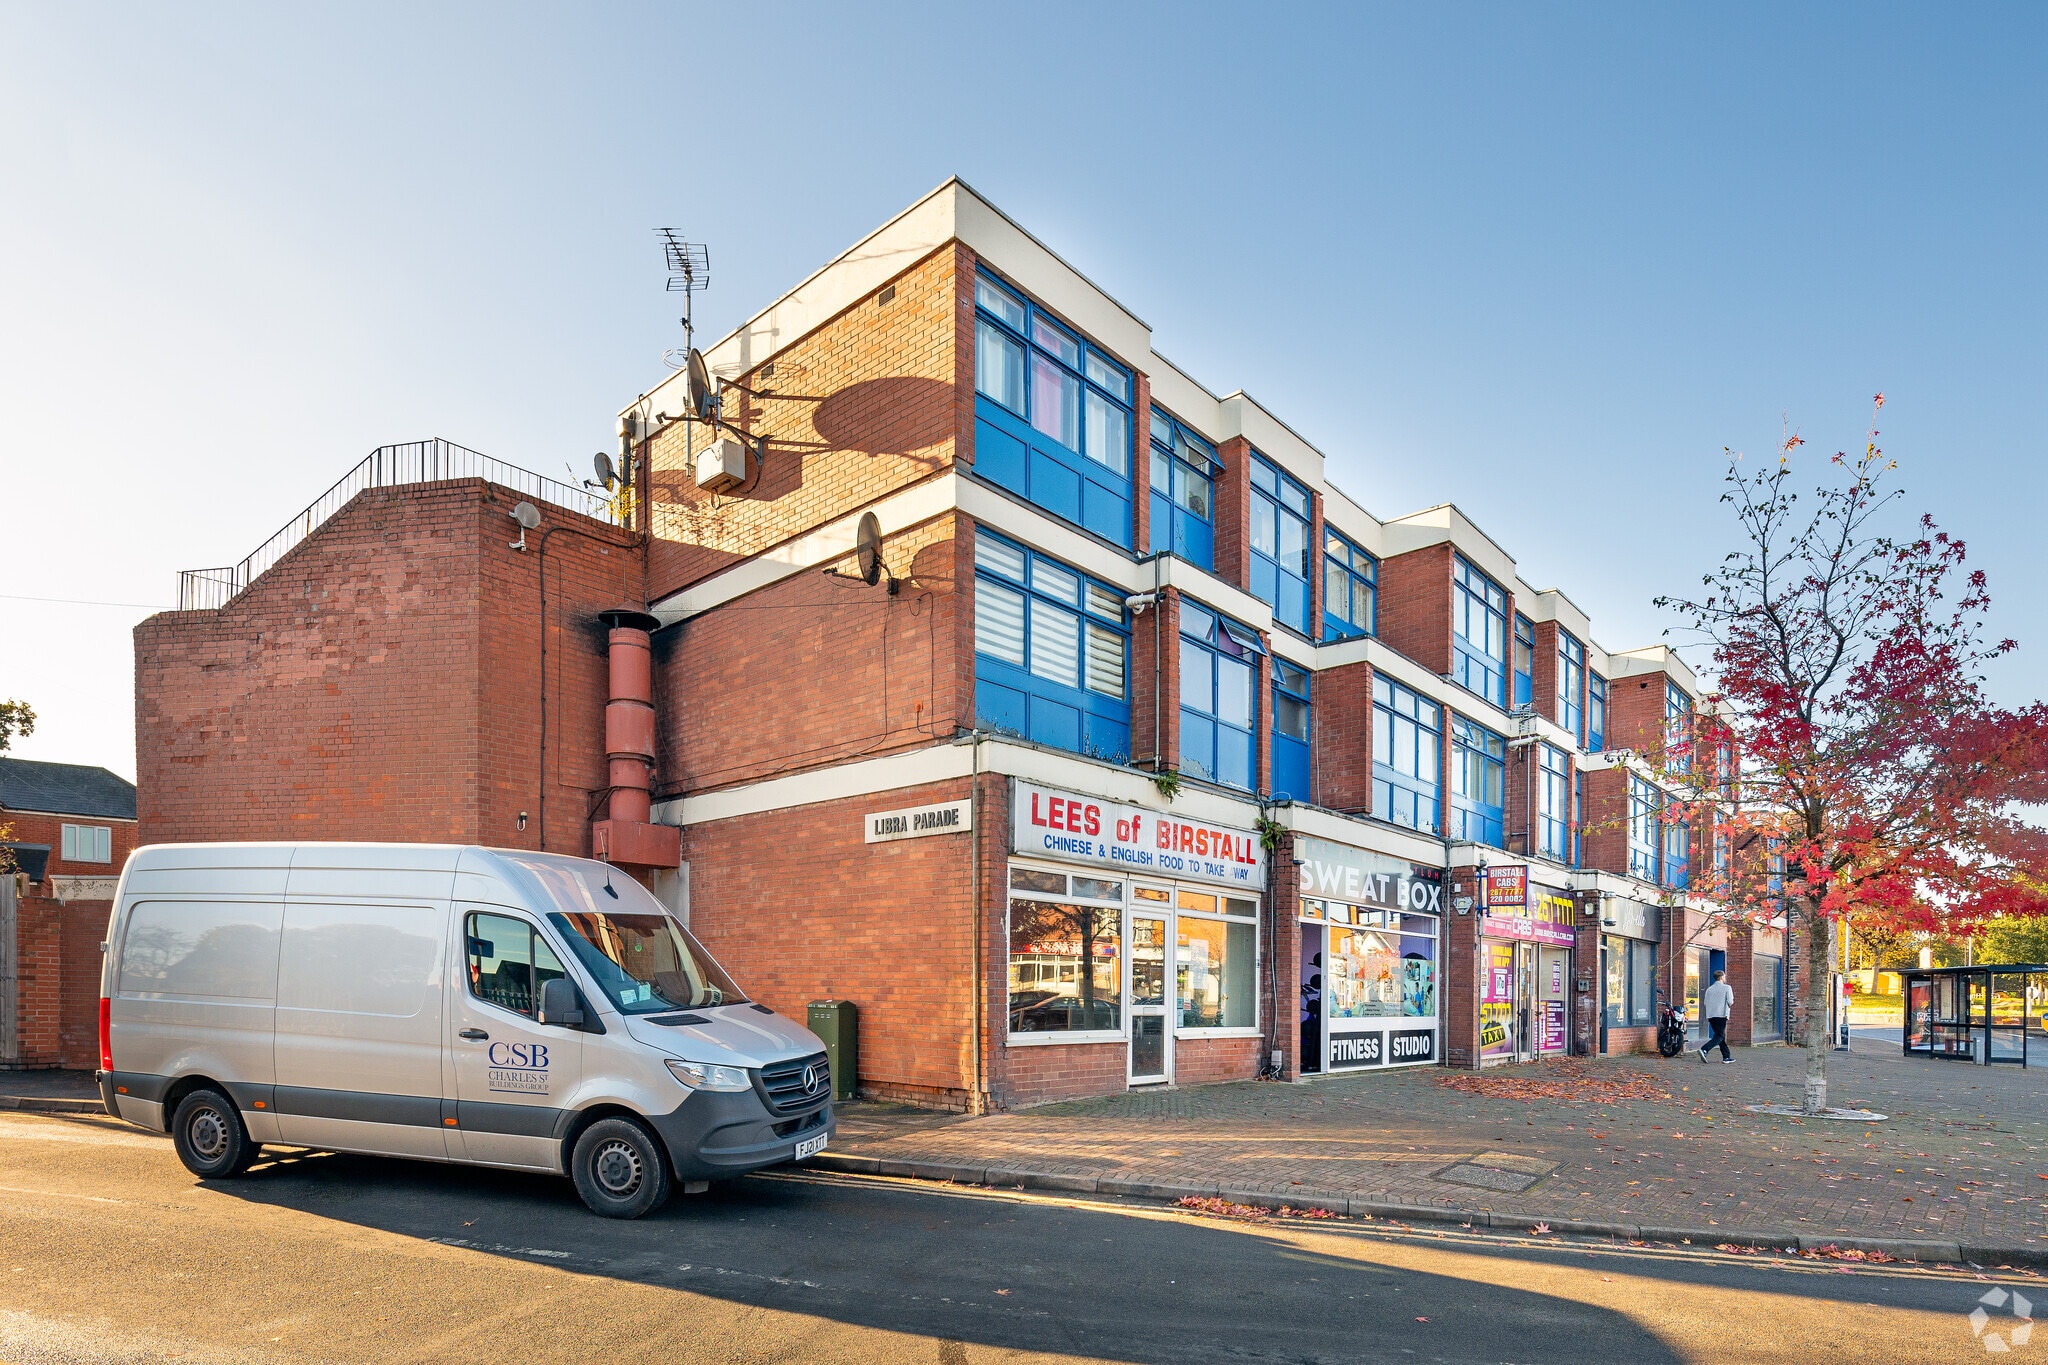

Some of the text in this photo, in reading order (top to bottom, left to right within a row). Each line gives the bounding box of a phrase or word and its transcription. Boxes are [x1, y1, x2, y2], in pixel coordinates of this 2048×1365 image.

[874, 808, 959, 835] LIBRA PARADE
[1032, 792, 1256, 865] LEES of BIRSTALL
[1044, 834, 1092, 855] CHINESE
[1098, 844, 1105, 858] &
[1111, 846, 1153, 866] ENGLISH
[1159, 854, 1184, 871] FOOD
[1188, 860, 1200, 873] TO
[1204, 862, 1225, 877] TAKE
[1490, 868, 1525, 878] BIRSTALL
[1496, 878, 1517, 887] CABS
[1299, 858, 1441, 913] SWEAT BOX
[1505, 888, 1524, 896] 7777
[1482, 1028, 1504, 1045] TAXI
[488, 1041, 549, 1067] CSB
[1330, 1035, 1430, 1061] FITNESS STUDIO
[488, 1070, 537, 1083] CHARLES
[488, 1080, 549, 1091] BUILDINGS GROUP
